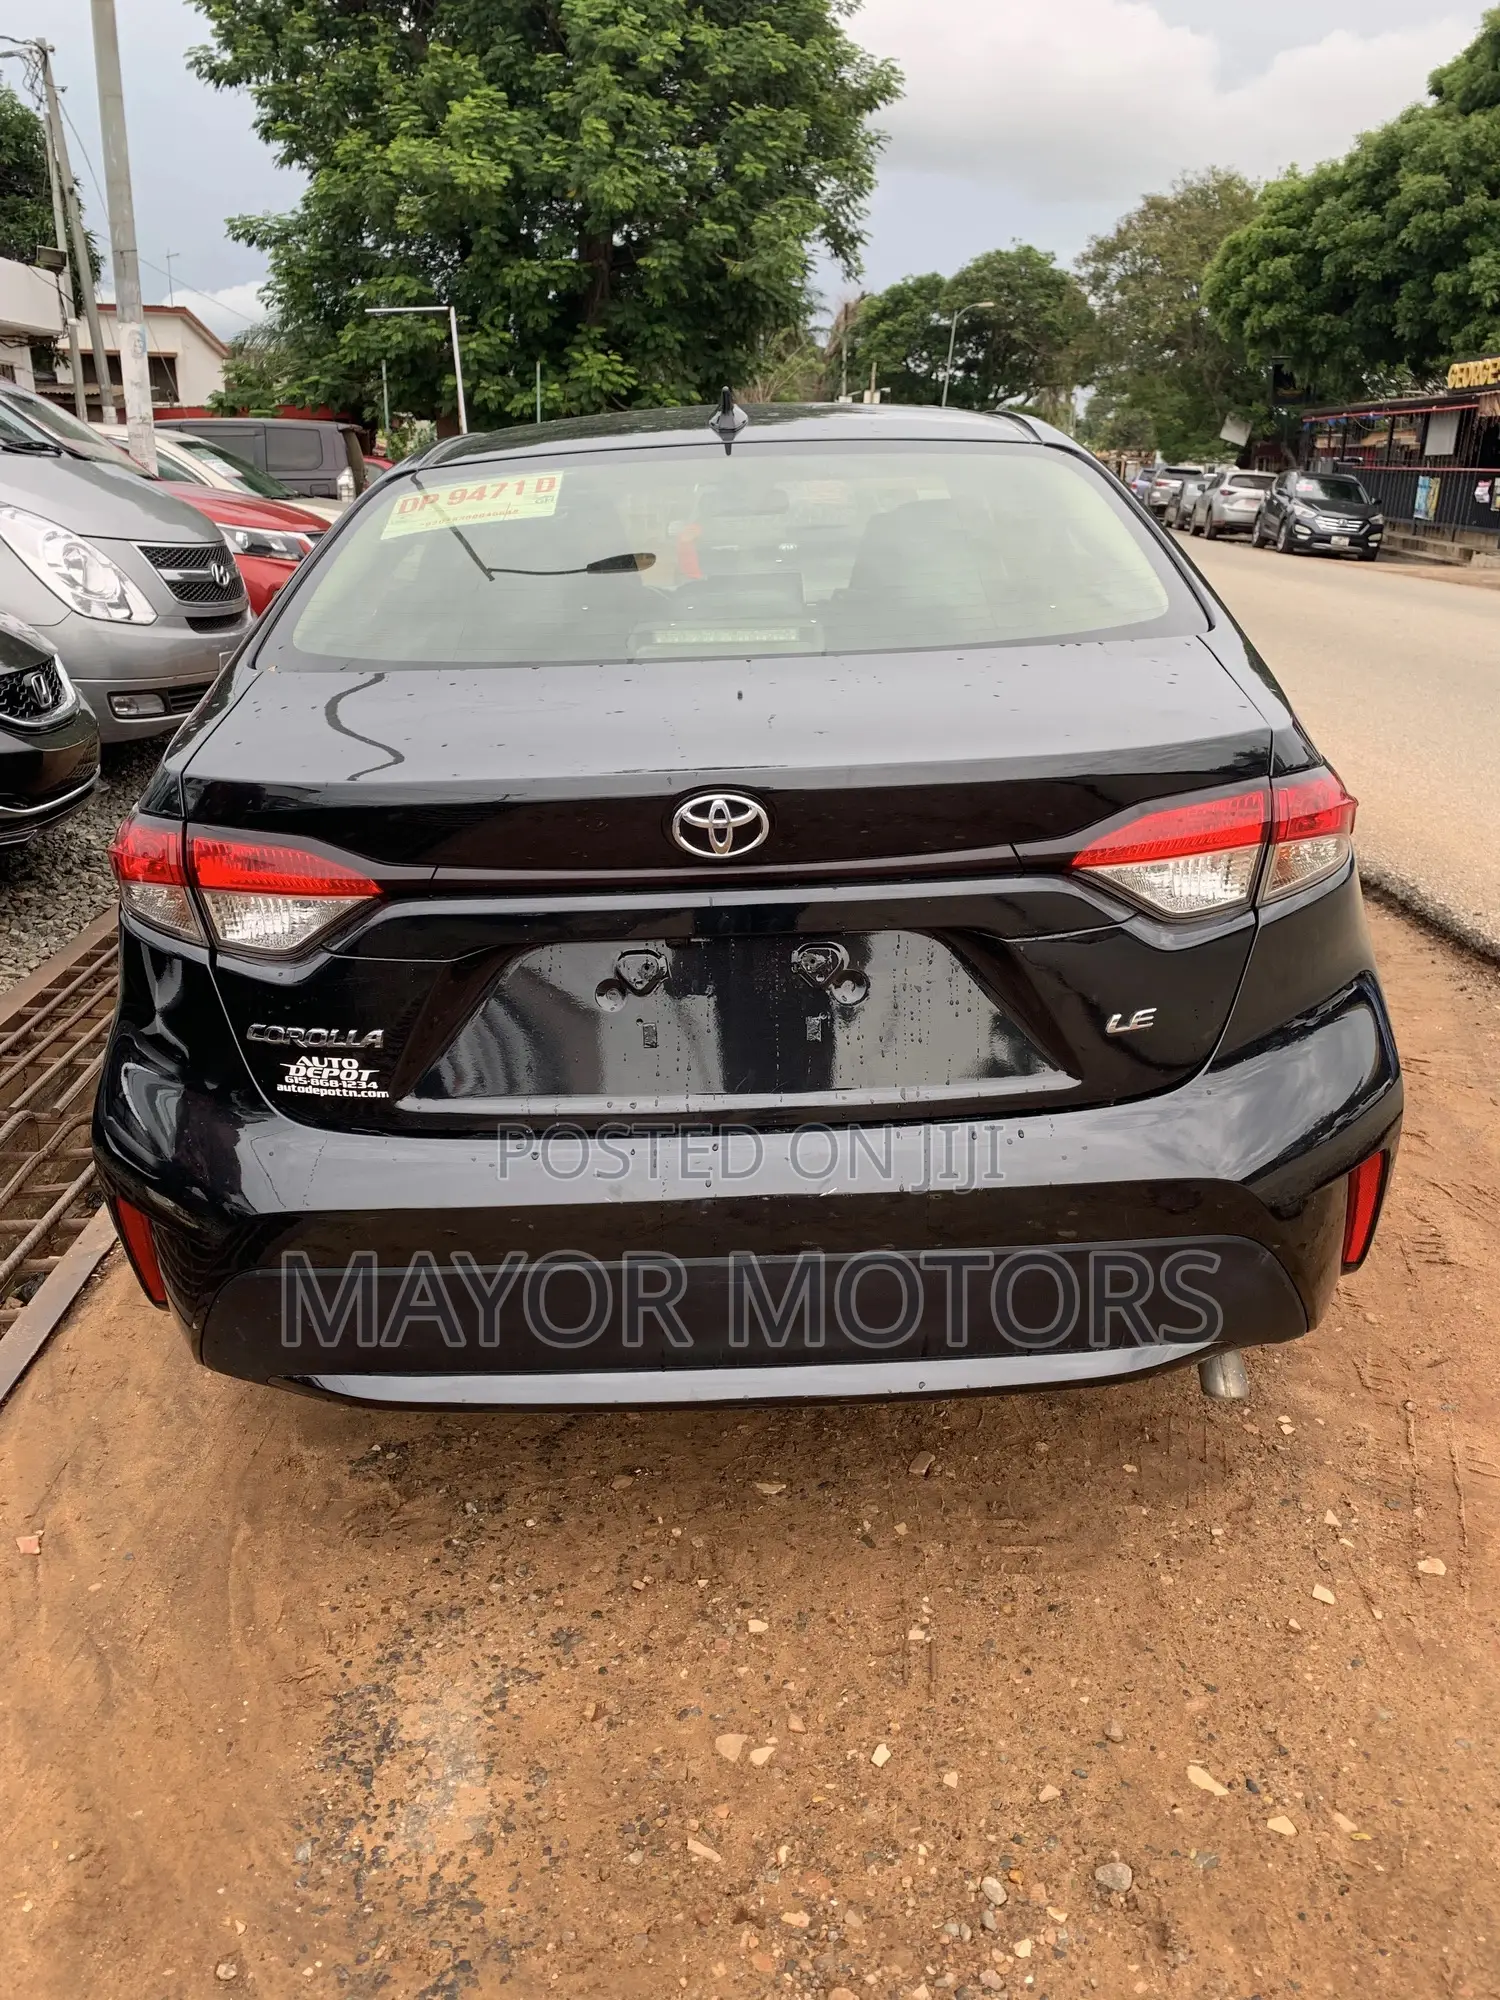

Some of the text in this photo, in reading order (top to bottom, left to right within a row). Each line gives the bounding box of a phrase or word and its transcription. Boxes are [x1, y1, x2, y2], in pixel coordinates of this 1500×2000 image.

[397, 493, 440, 515] DP
[446, 479, 526, 508] 9471
[534, 476, 557, 494] D
[1105, 1007, 1158, 1034] LE
[246, 1023, 385, 1048] COROLLA
[296, 1055, 359, 1070] AUTO
[279, 1063, 380, 1081] DEPOT
[276, 1083, 390, 1099] autodepottn.com
[284, 1075, 379, 1090] 615-868-1234
